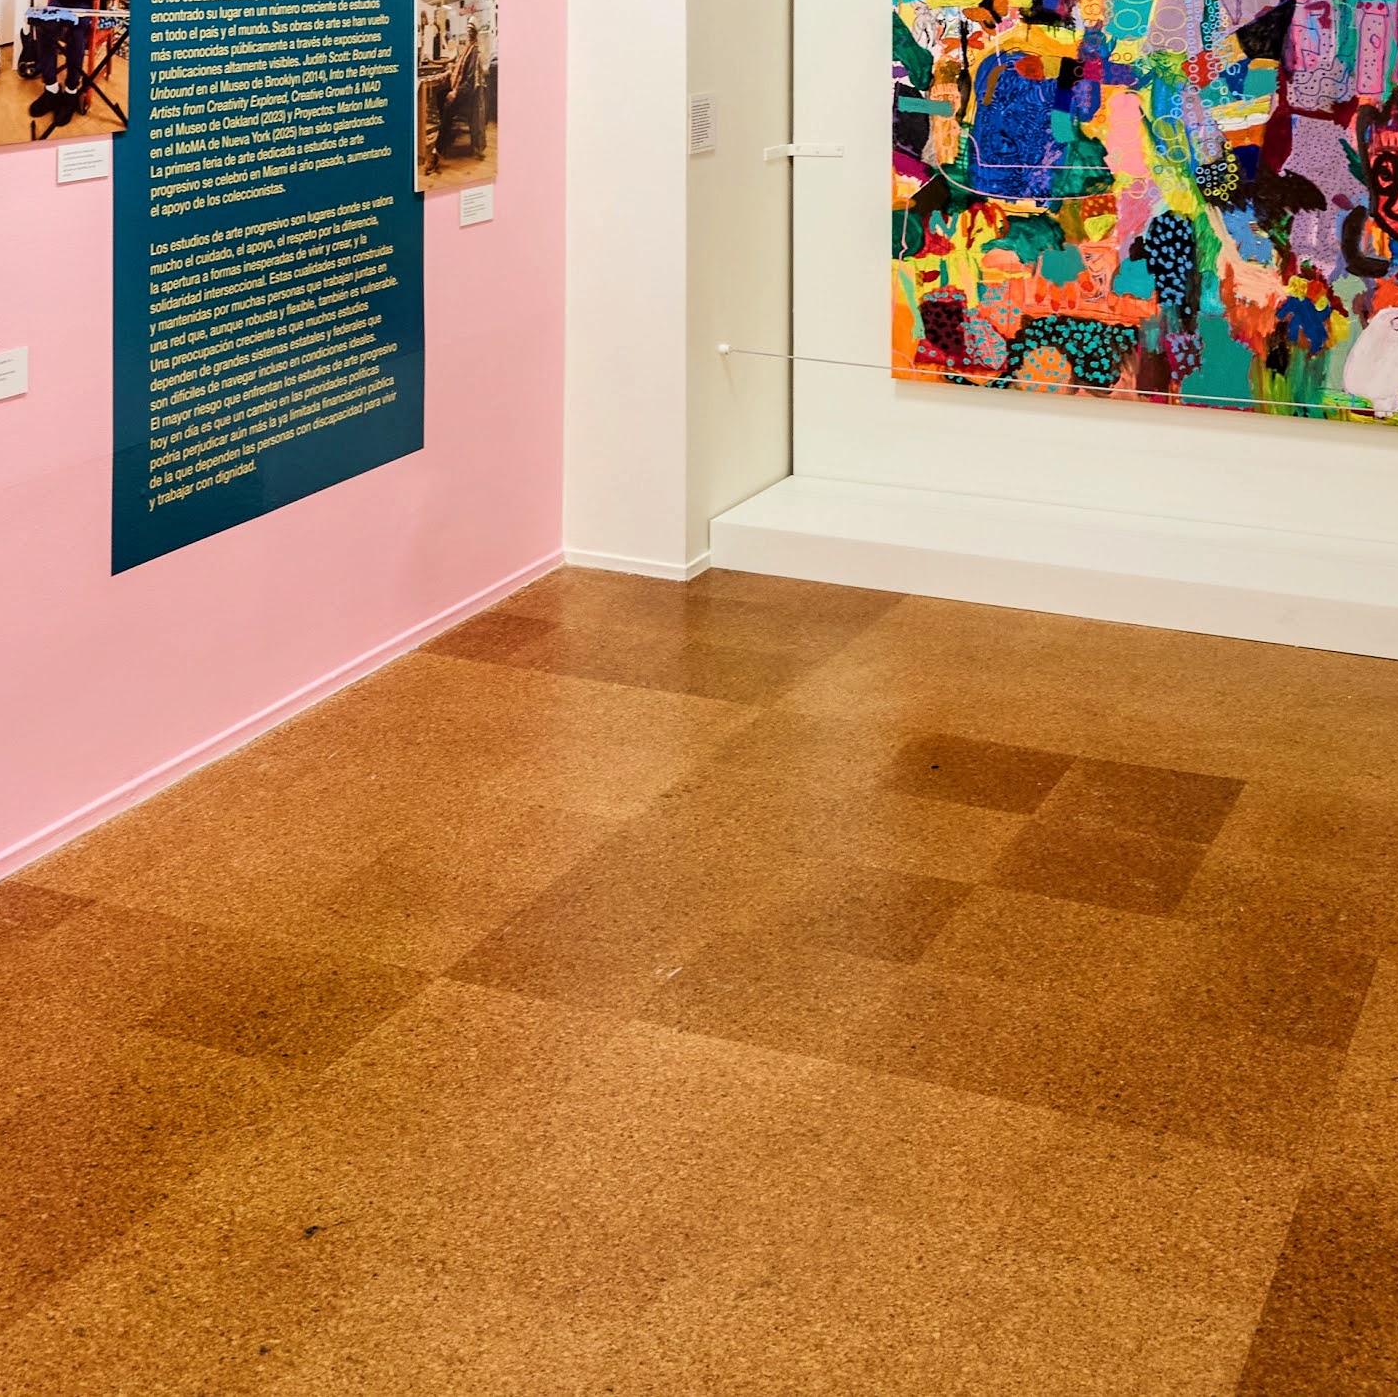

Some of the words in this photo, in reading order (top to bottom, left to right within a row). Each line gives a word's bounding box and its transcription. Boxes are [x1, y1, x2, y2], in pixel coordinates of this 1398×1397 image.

[150, 243, 169, 257] Los
[169, 233, 211, 252] estudios
[211, 229, 225, 243] de
[224, 226, 244, 241] arte
[244, 217, 290, 239] progresivo
[290, 214, 307, 227] son
[306, 208, 337, 224] lugares
[336, 201, 362, 217] donde
[361, 200, 372, 211] se
[371, 195, 395, 209] valora
[148, 498, 156, 513] y
[156, 483, 195, 506] trabajar
[195, 476, 214, 492] con
[214, 459, 257, 485] dignidad.
